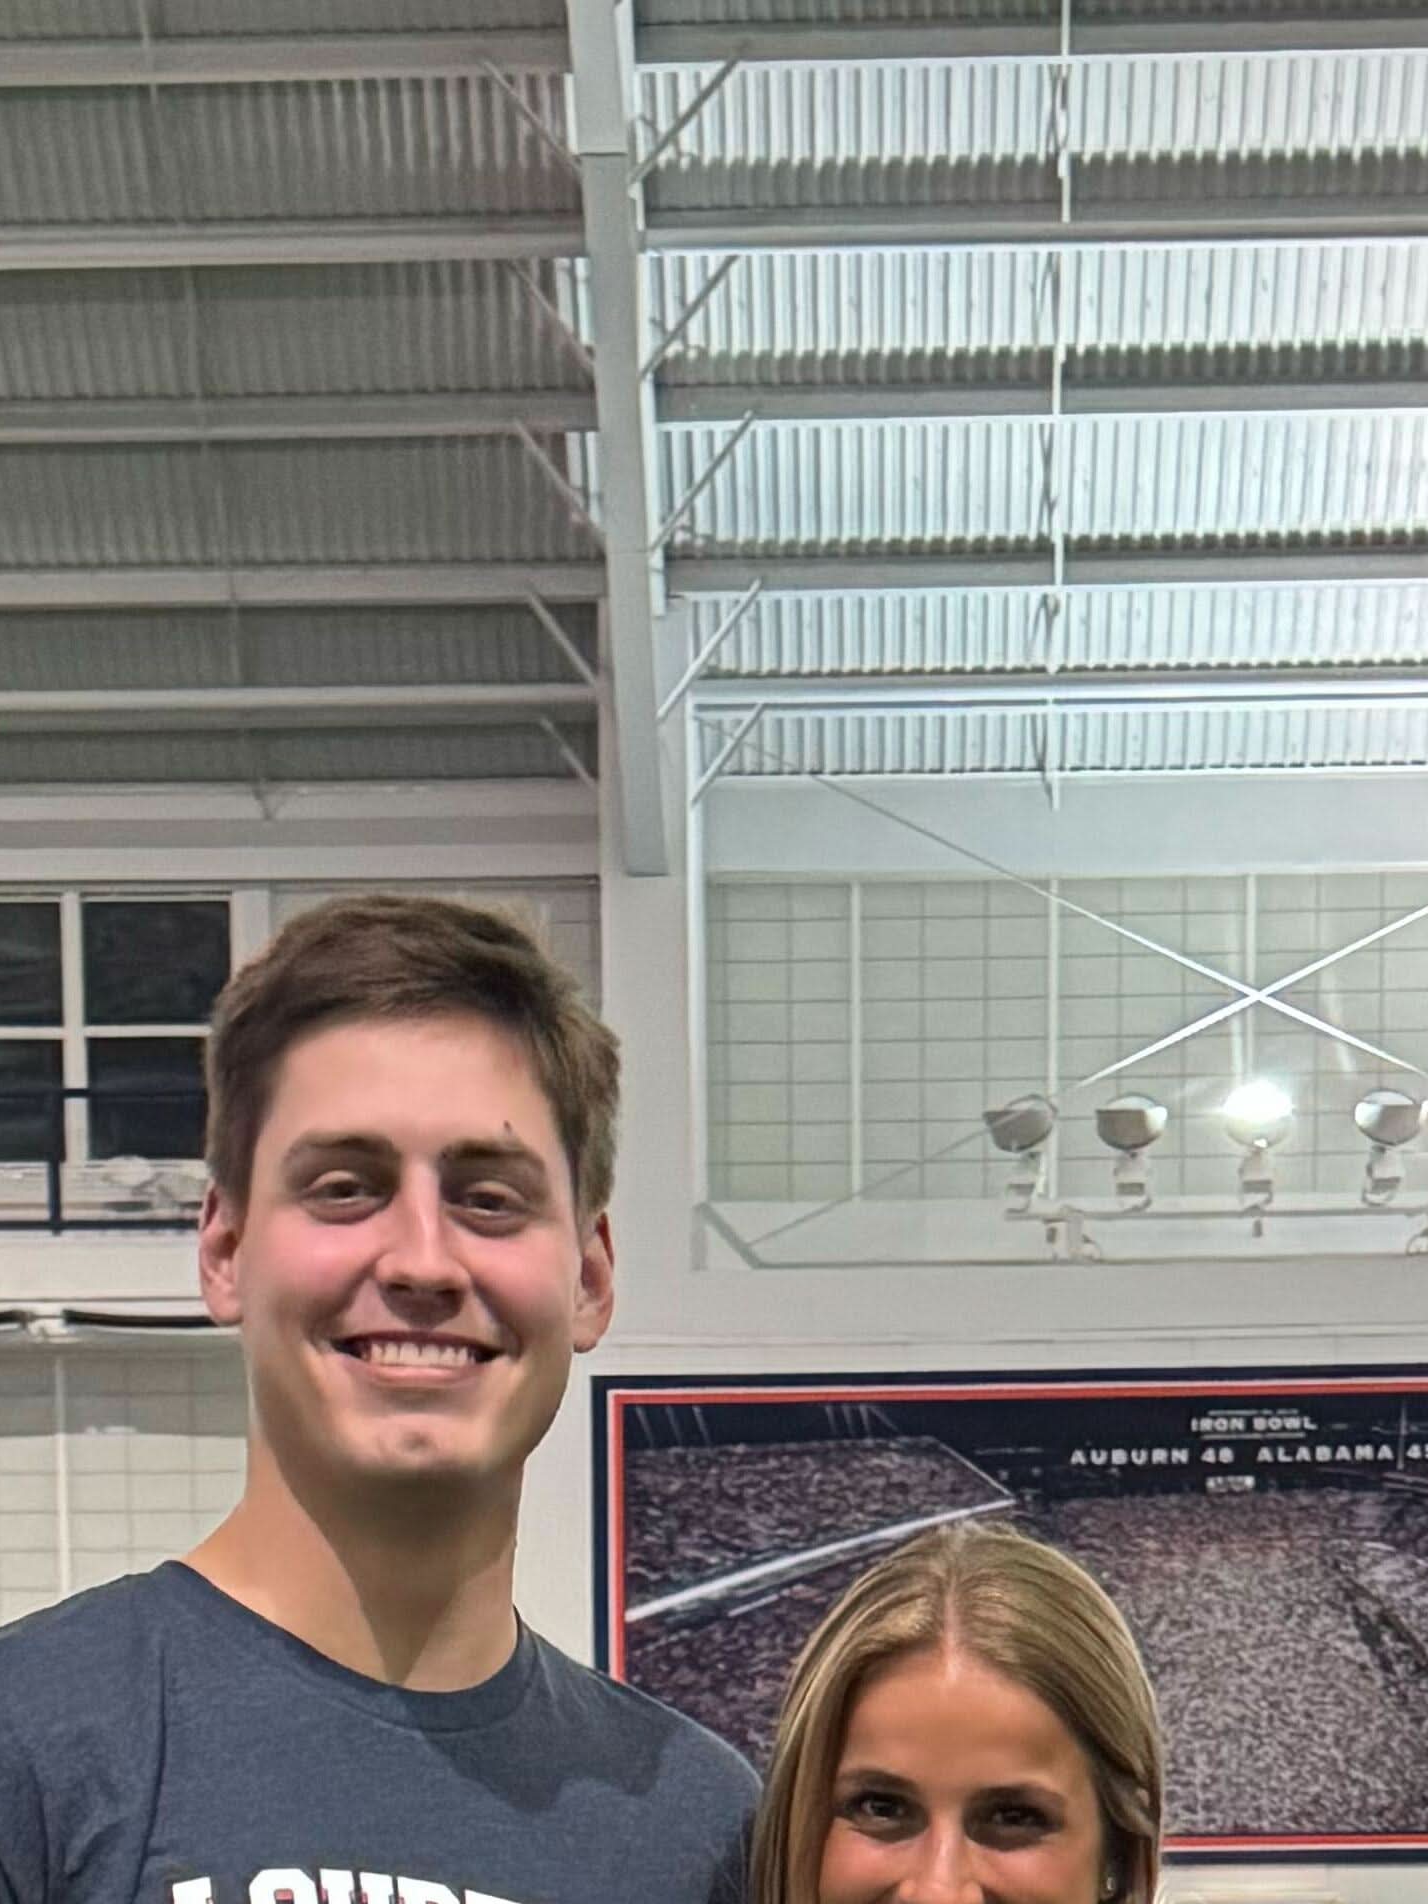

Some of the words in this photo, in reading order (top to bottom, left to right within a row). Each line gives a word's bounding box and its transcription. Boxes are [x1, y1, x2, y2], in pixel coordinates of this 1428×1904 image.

[1252, 1414, 1318, 1431] BOWL
[1070, 1447, 1190, 1466] AUBURN
[1256, 1443, 1394, 1463] ALABAMA
